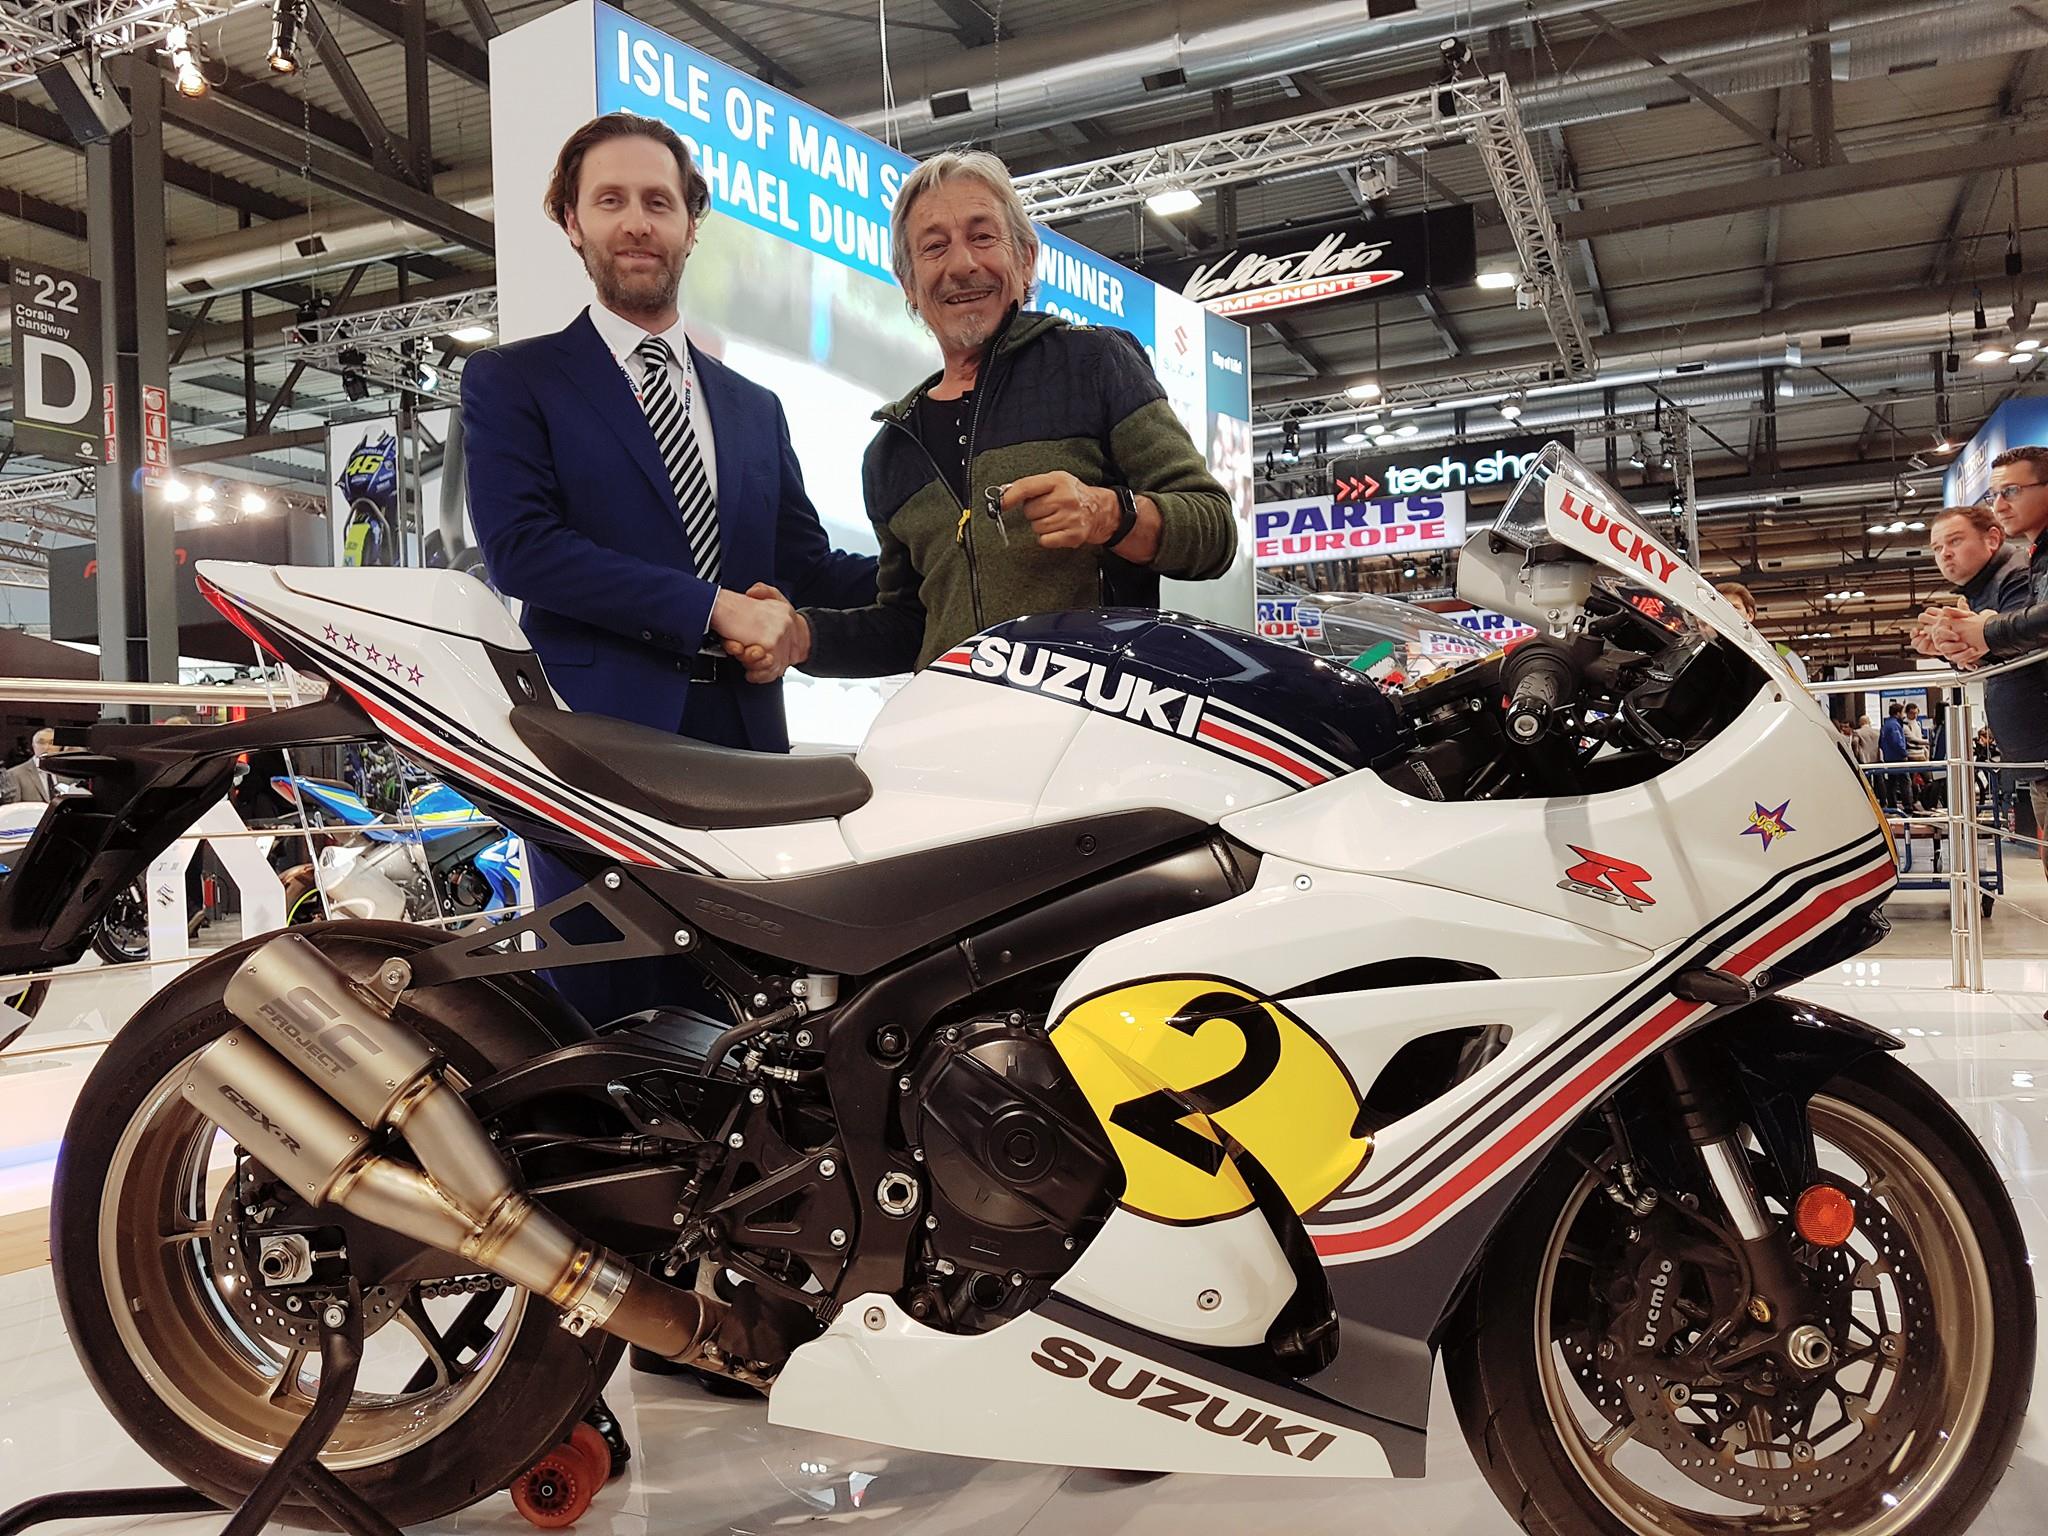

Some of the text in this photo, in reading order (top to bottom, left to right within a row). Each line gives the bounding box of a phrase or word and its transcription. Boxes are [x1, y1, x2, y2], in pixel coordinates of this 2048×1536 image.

[617, 29, 711, 123] ISLE
[725, 87, 775, 150] OF
[788, 115, 869, 199] MAN
[809, 192, 894, 272] DUNL
[34, 274, 79, 314] 22
[1037, 243, 1125, 318] WINNER
[1211, 274, 1372, 313] OMPONENTS
[17, 316, 70, 339] Gangway
[23, 334, 93, 425] D
[346, 454, 384, 476] 46
[1385, 450, 1543, 495] tech.sho
[1256, 494, 1445, 538] PARTS
[1256, 521, 1445, 557] EUROPE
[1559, 488, 1679, 584] LUCKY
[970, 636, 1205, 738] SUZUKI
[1856, 664, 1879, 672] MERIDA
[1749, 810, 1787, 840] LUCKY
[258, 1003, 346, 1073] PROJECT
[1109, 991, 1282, 1178] 2
[217, 1084, 301, 1157] GSX-R
[1638, 1260, 1673, 1347] brembo
[1030, 1336, 1337, 1461] SUZUKI
